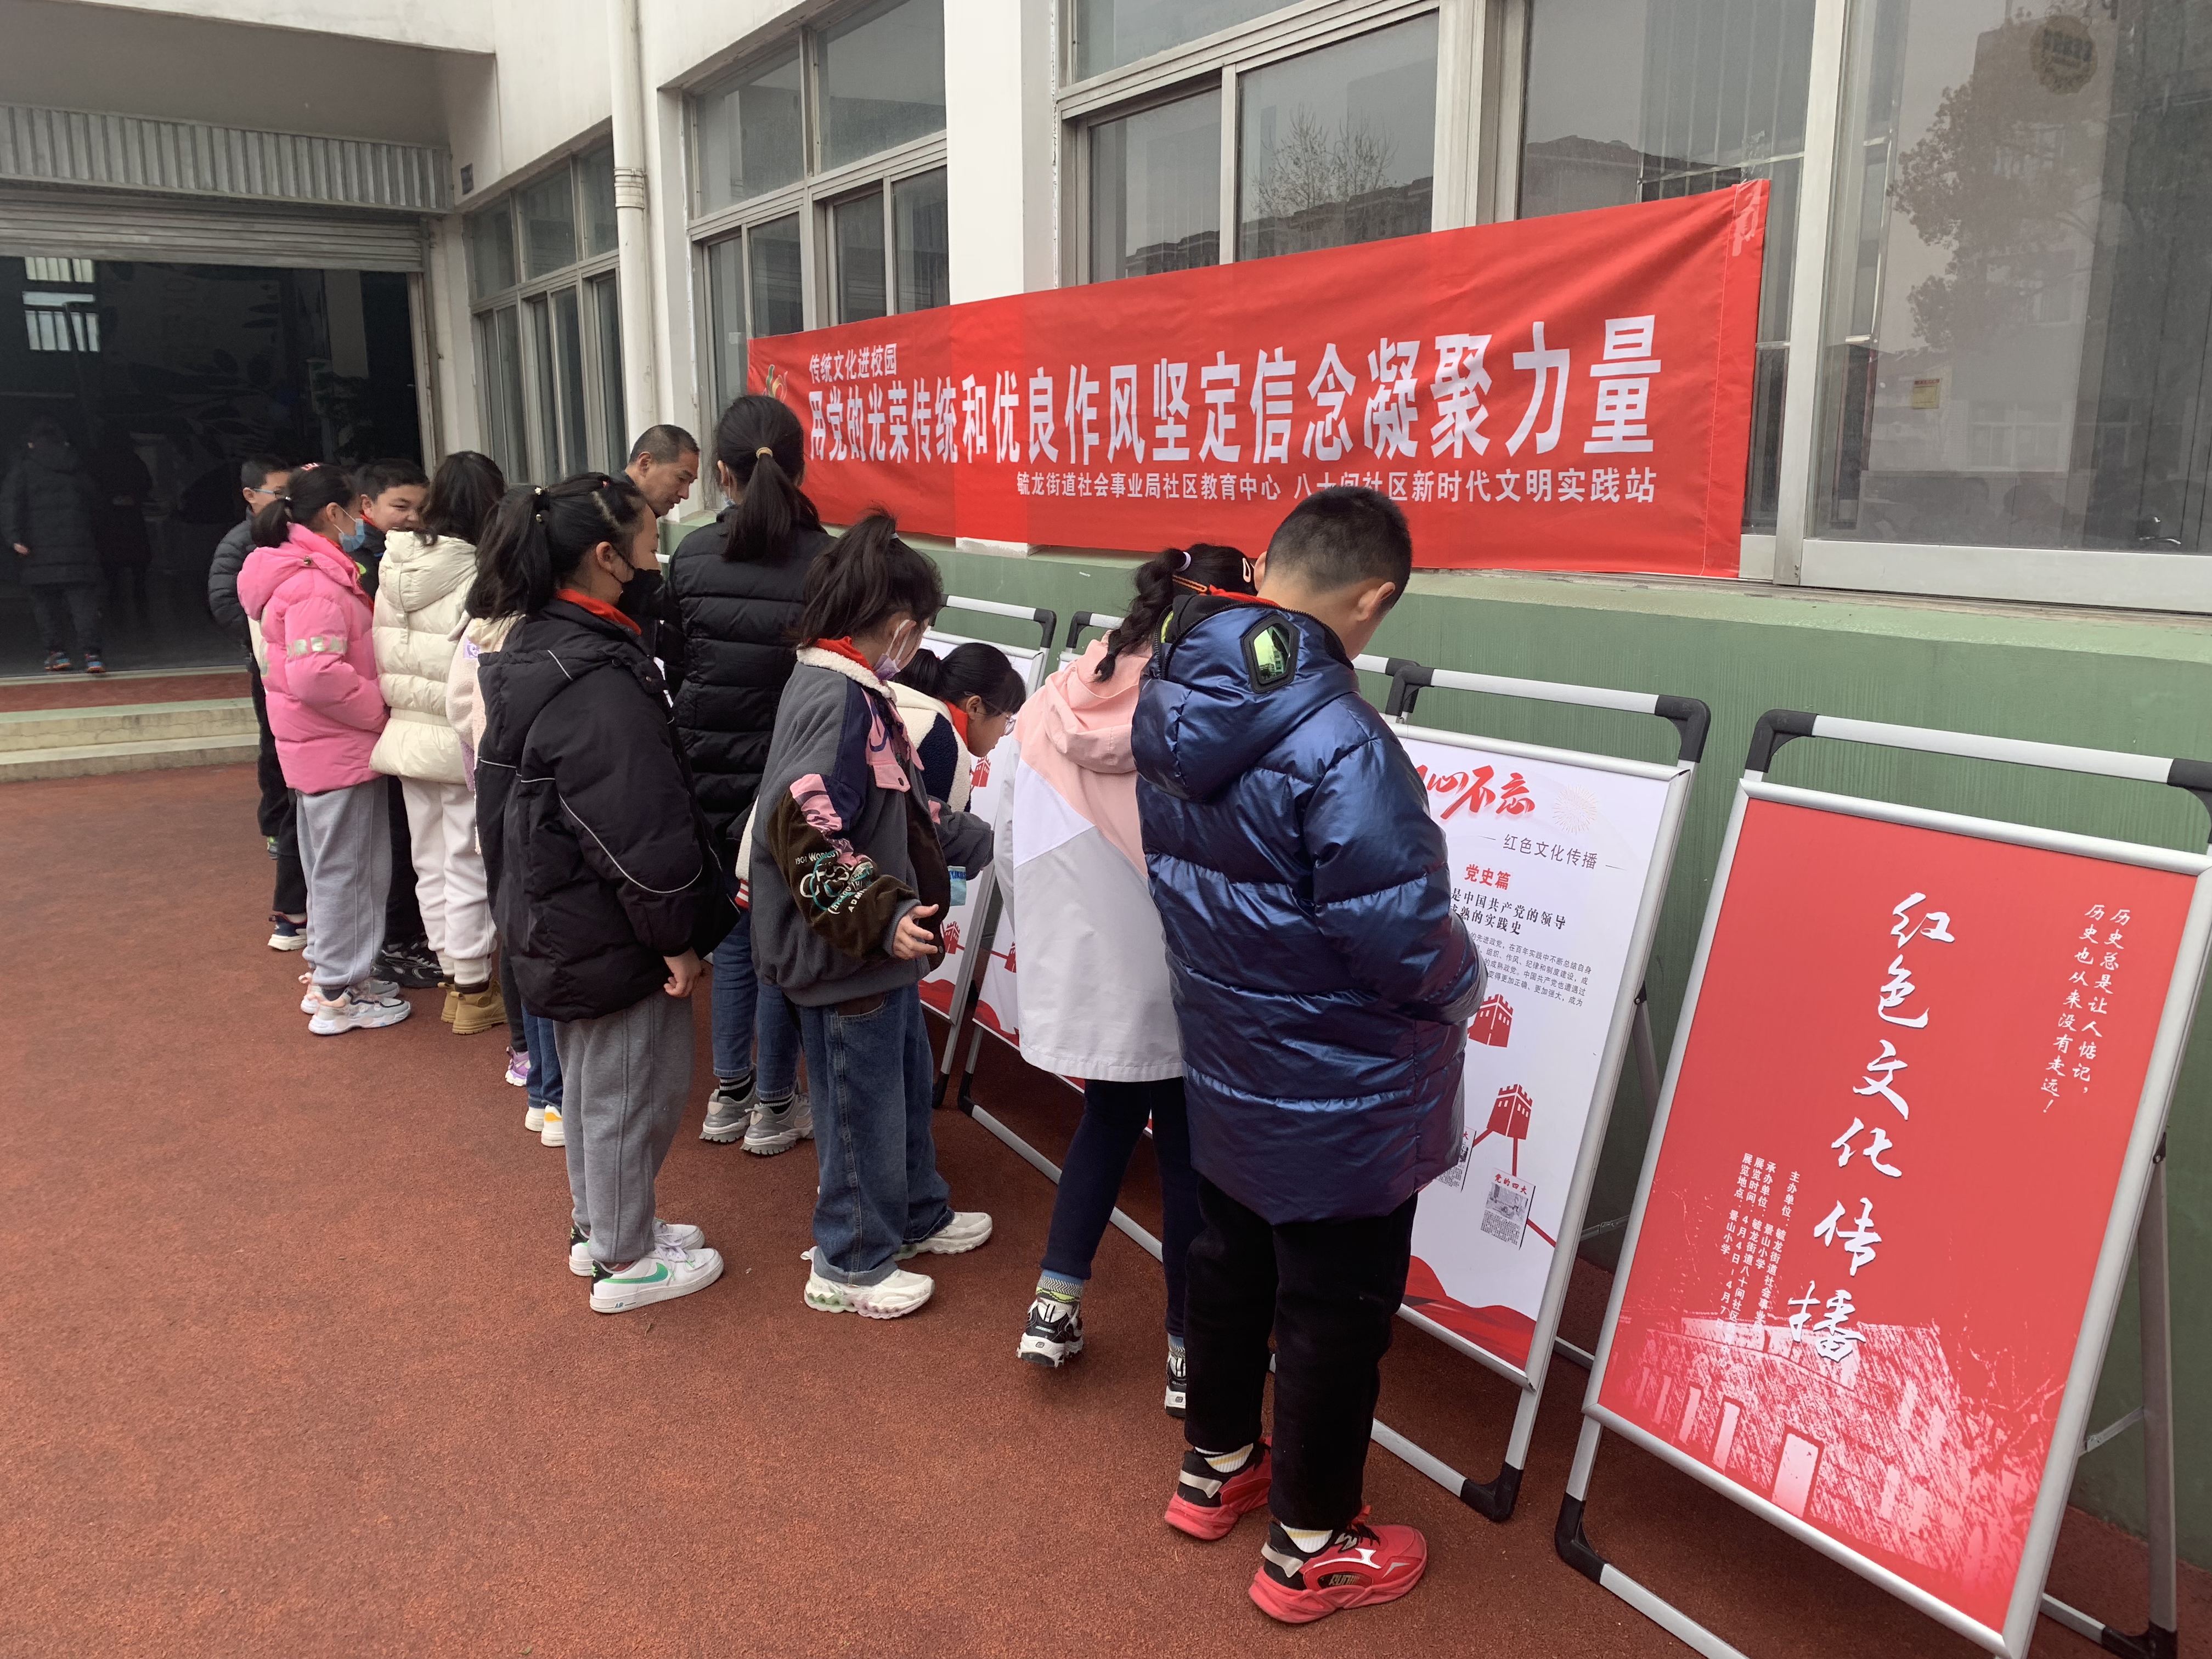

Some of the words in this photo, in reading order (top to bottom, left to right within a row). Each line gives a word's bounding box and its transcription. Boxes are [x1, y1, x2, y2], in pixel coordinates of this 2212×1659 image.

[809, 342, 898, 384] 传统文化进校园
[809, 314, 1661, 464] 用党的光荣传统和优良作风坚定信念凝聚力量
[1017, 470, 1282, 501] 毓龙街道社会事业局社区教育中心
[1415, 764, 1536, 820] 心不忘
[1503, 833, 1598, 870] 红色文化传播
[1464, 863, 1511, 890] 党史篇
[1451, 888, 1566, 930] 是中国共产党的领导
[1468, 930, 1592, 974] 的先进政党，在百年实践中不断总结自身
[2040, 904, 2106, 1113] 历史也从来没有走远！
[2072, 909, 2131, 1094] 历史总是让人惦记，
[1787, 892, 1955, 1363] 红色文化传播
[1755, 1223, 1775, 1271] 景山小学
